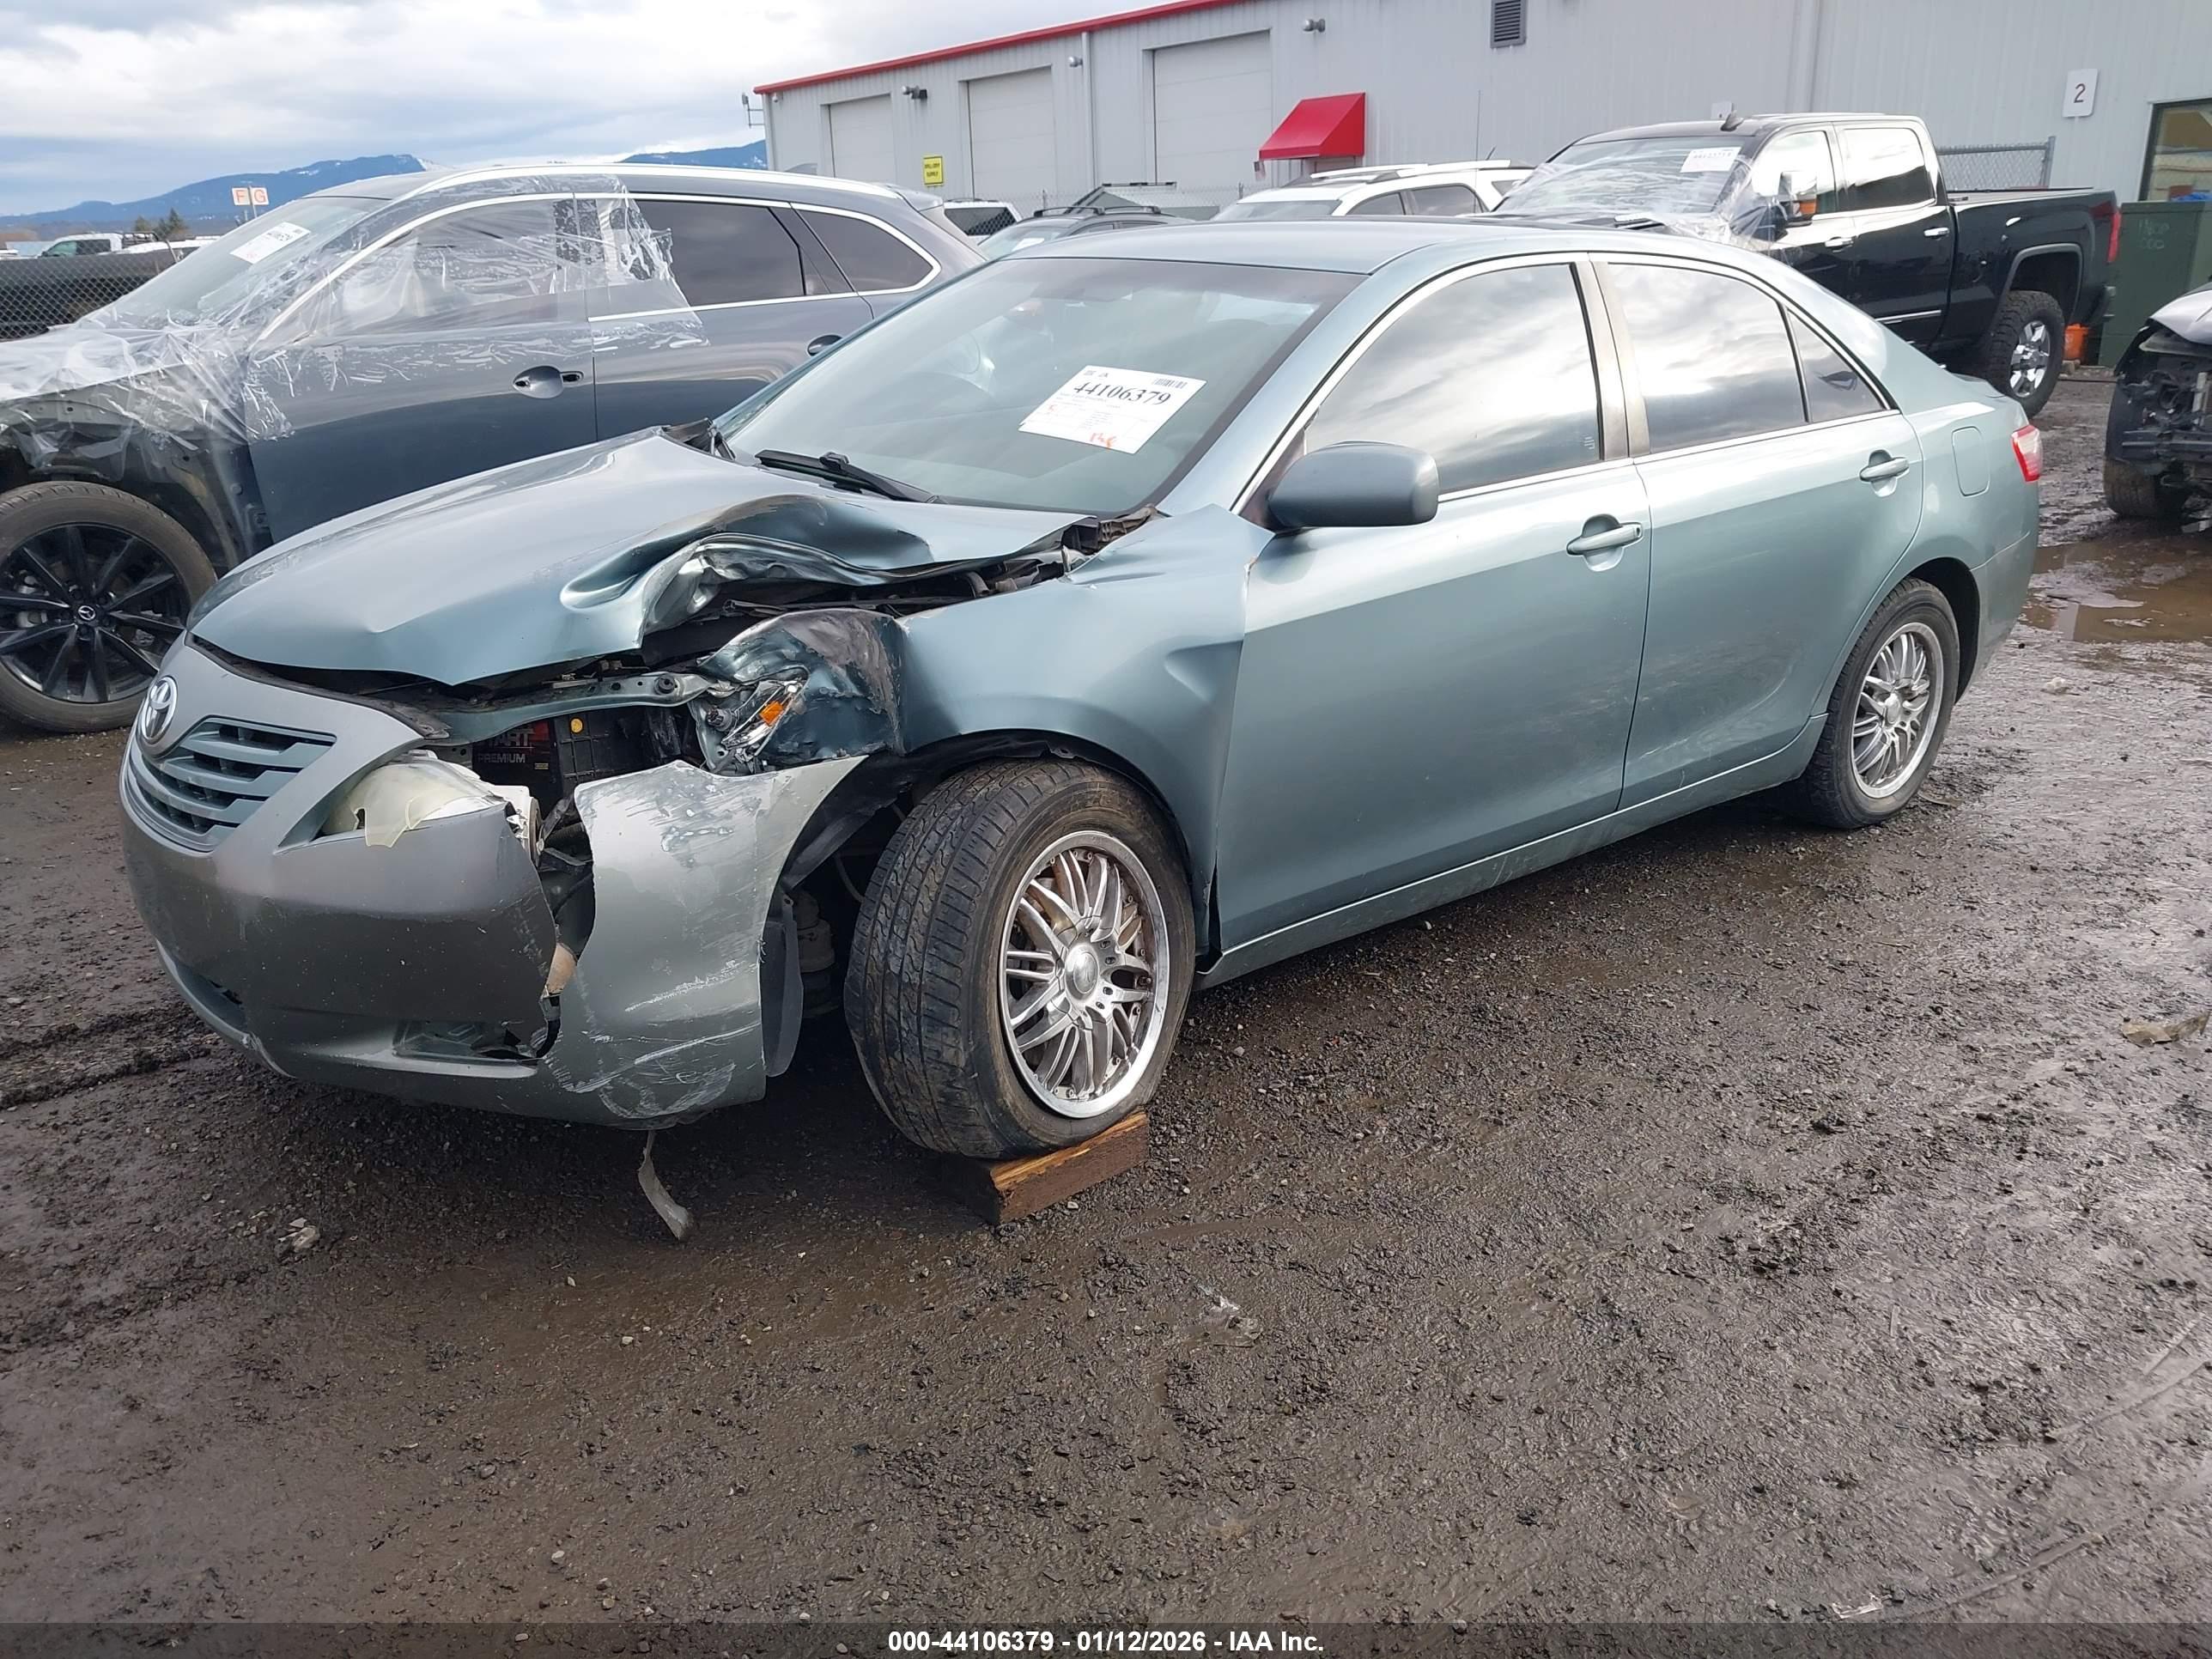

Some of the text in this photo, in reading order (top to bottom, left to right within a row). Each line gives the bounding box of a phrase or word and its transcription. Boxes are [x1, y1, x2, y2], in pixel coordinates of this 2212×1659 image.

[2074, 83, 2086, 103] 2
[236, 190, 246, 204] F
[253, 189, 267, 204] G
[1073, 381, 1171, 405] 44106379
[477, 753, 526, 763] PREMIUM
